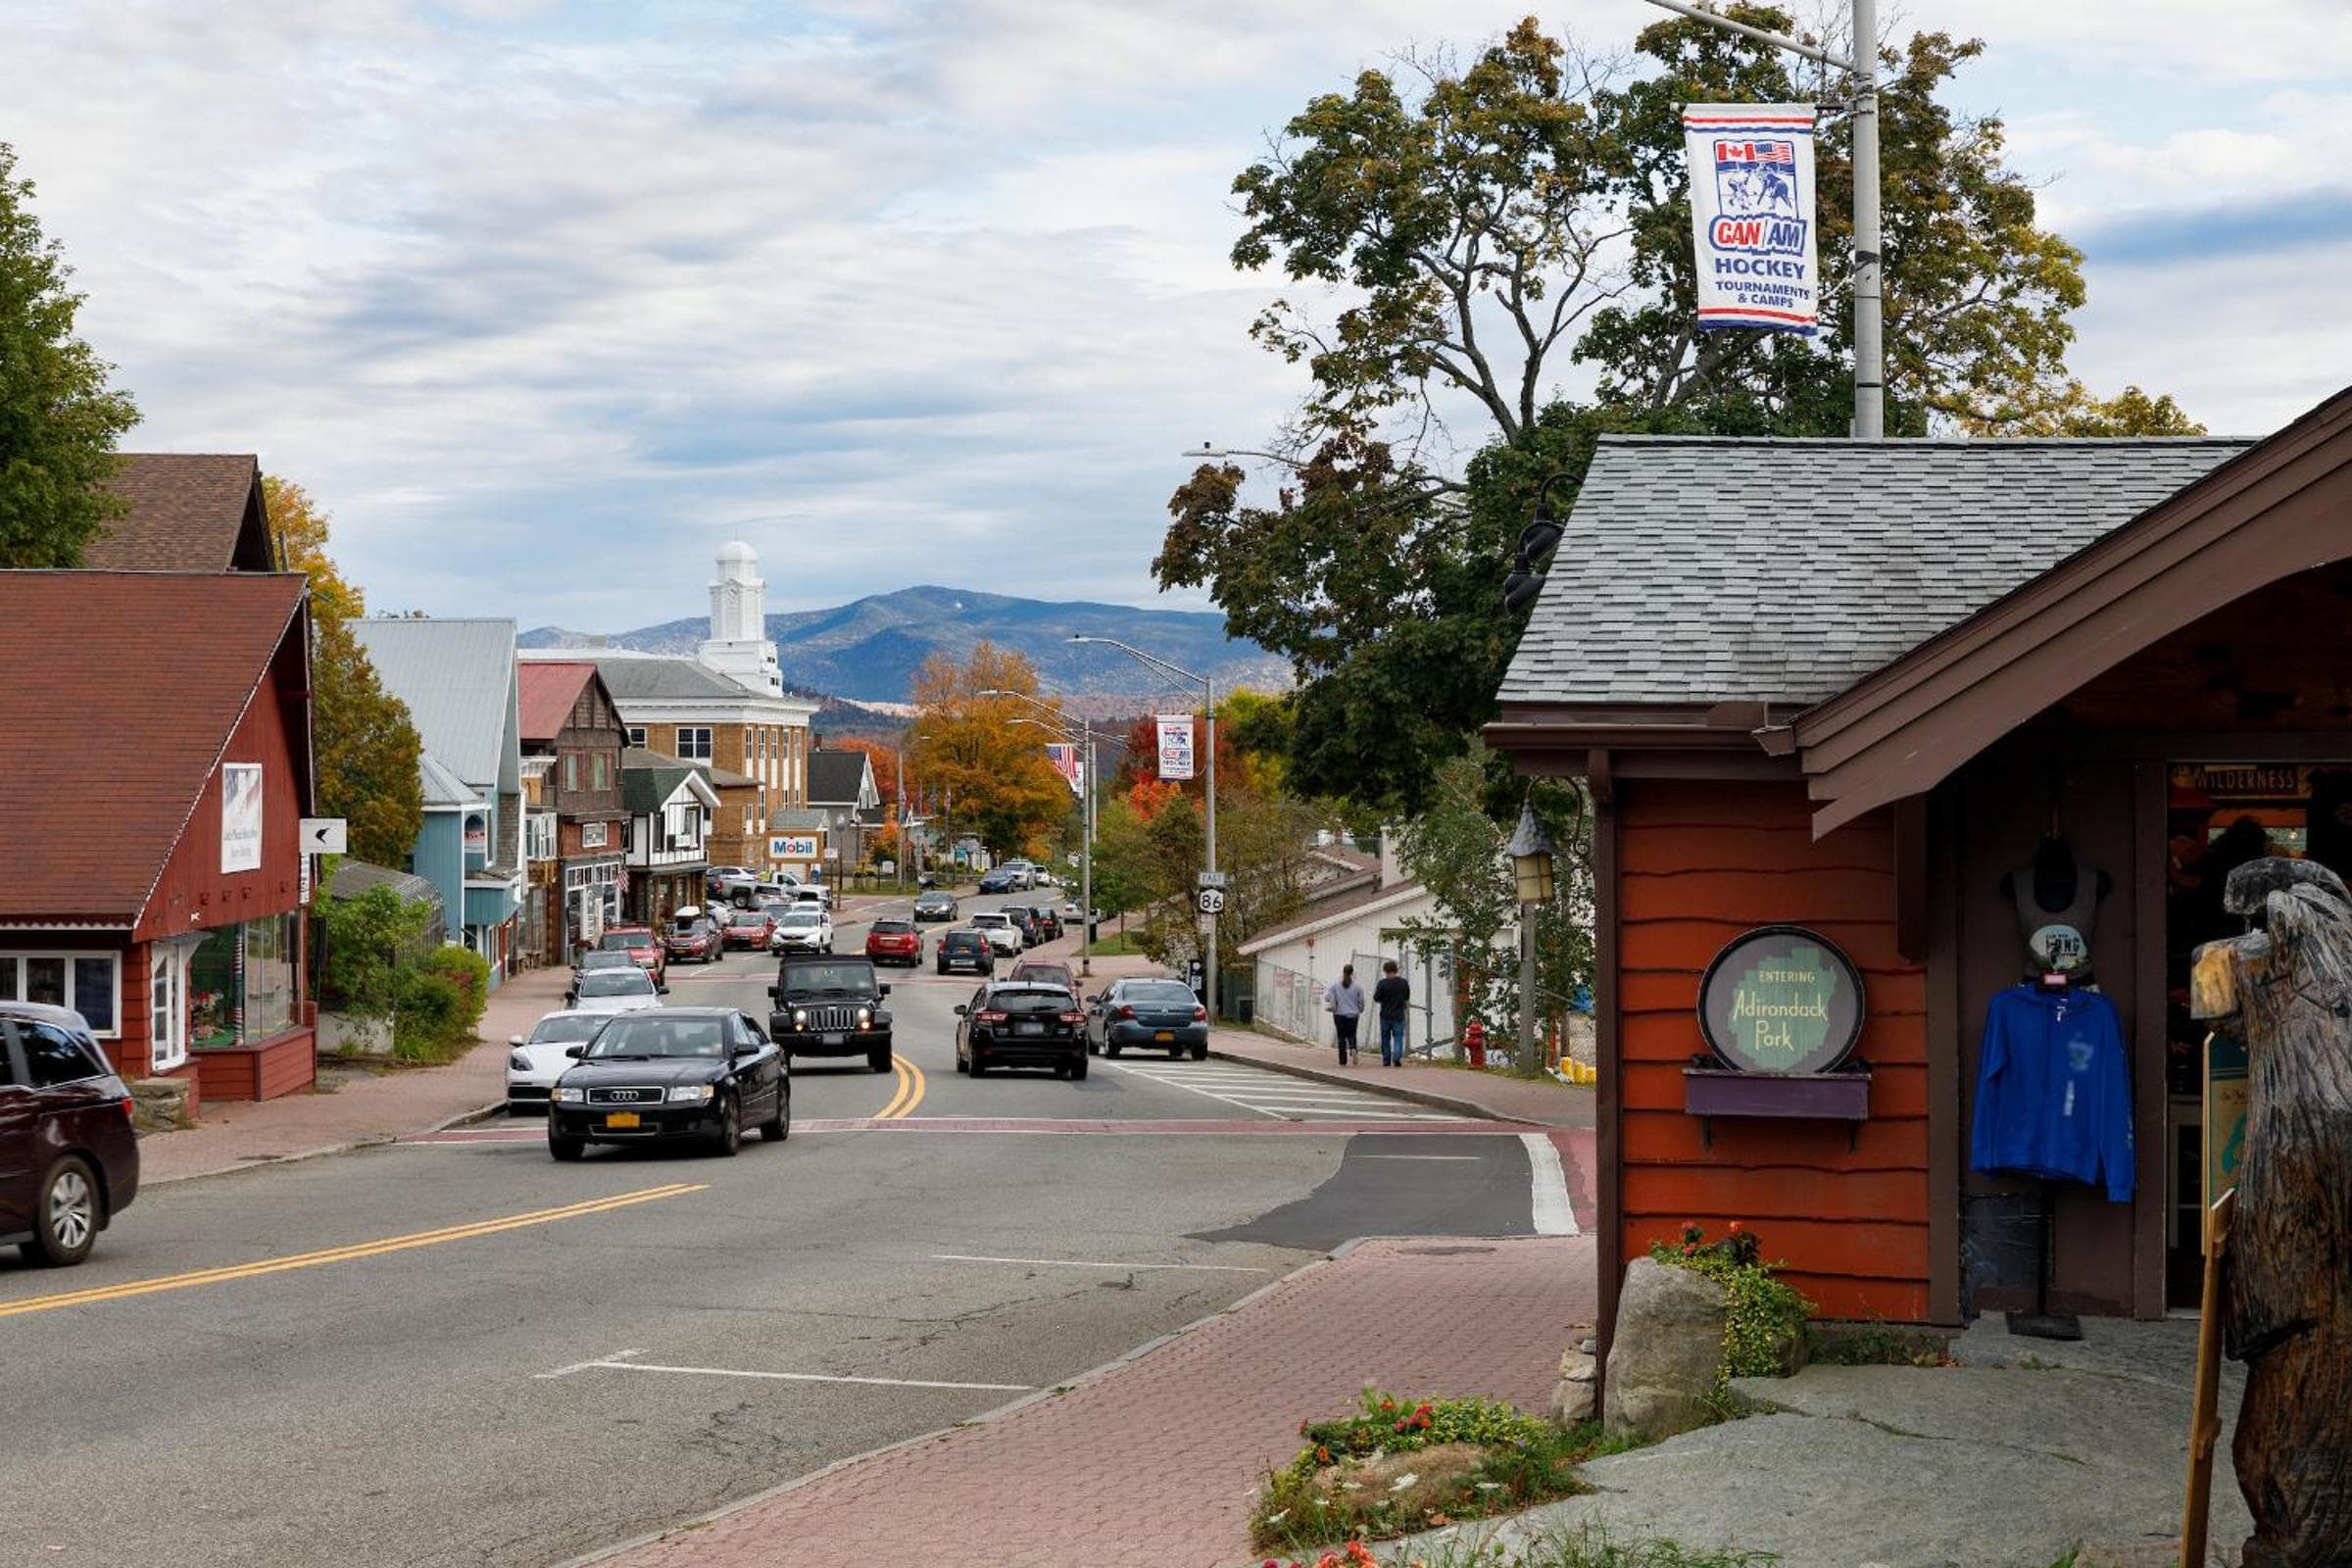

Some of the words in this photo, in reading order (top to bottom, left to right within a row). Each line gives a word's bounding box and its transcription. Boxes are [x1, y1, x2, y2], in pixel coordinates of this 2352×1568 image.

[1715, 258, 1804, 279] HOCKEY
[1715, 281, 1810, 299] TOURNAMENTS
[1738, 293, 1748, 304] &
[1750, 294, 1794, 308] CAMPS
[2193, 769, 2295, 791] WILDERNESS
[774, 841, 812, 854] Mobil
[1201, 895, 1222, 908] 86
[1759, 970, 1815, 983] ENTERING
[1733, 989, 1829, 1021] Adirondack
[1755, 1019, 1794, 1053] Park
